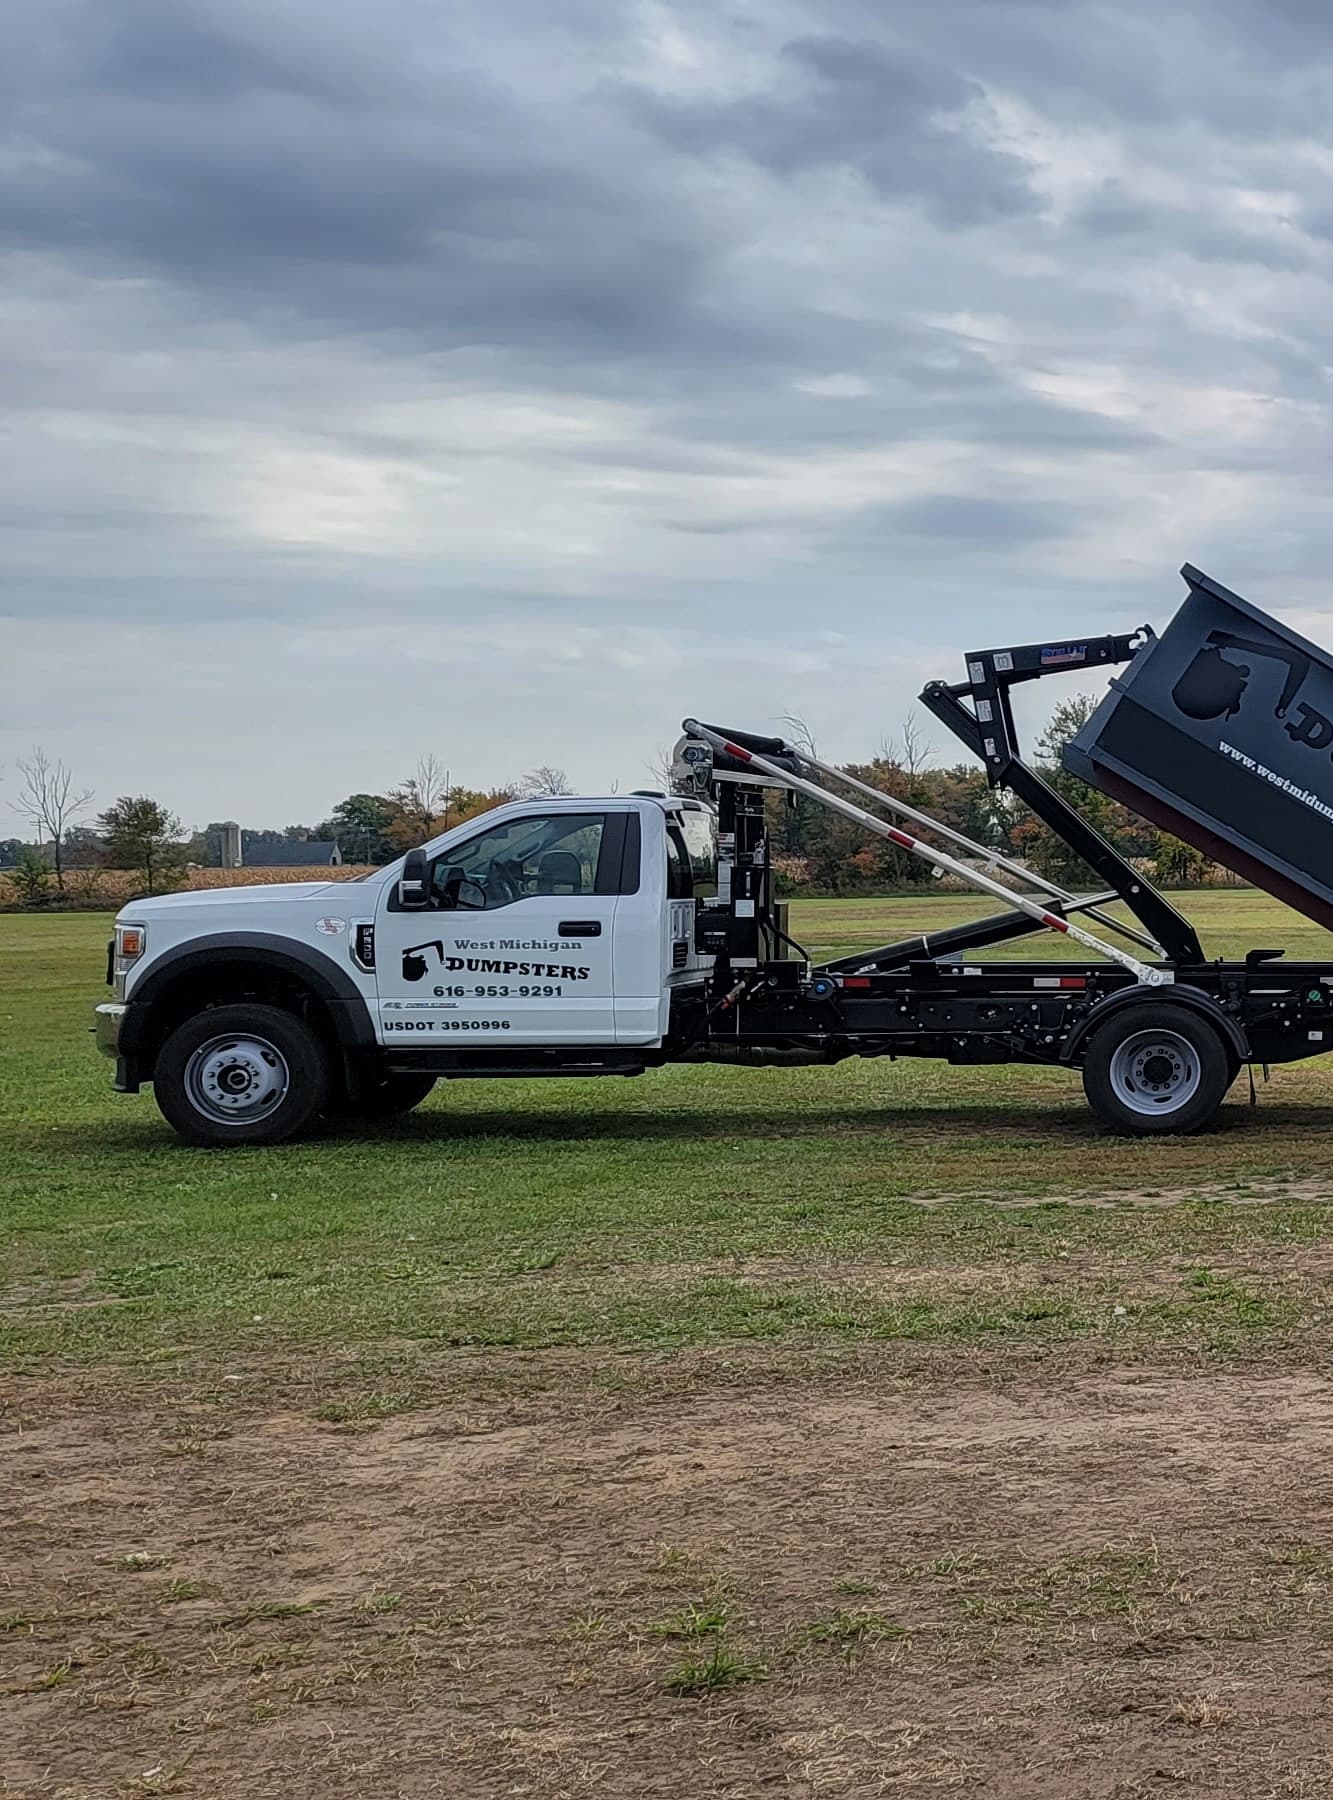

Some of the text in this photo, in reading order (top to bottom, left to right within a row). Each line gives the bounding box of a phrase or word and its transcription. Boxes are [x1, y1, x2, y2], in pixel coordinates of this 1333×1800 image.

[454, 939, 582, 952] West Michigan
[445, 957, 591, 981] DUMPSTERS
[433, 985, 563, 997] 616-953-9291
[384, 1020, 511, 1031] USDOT 3950996
